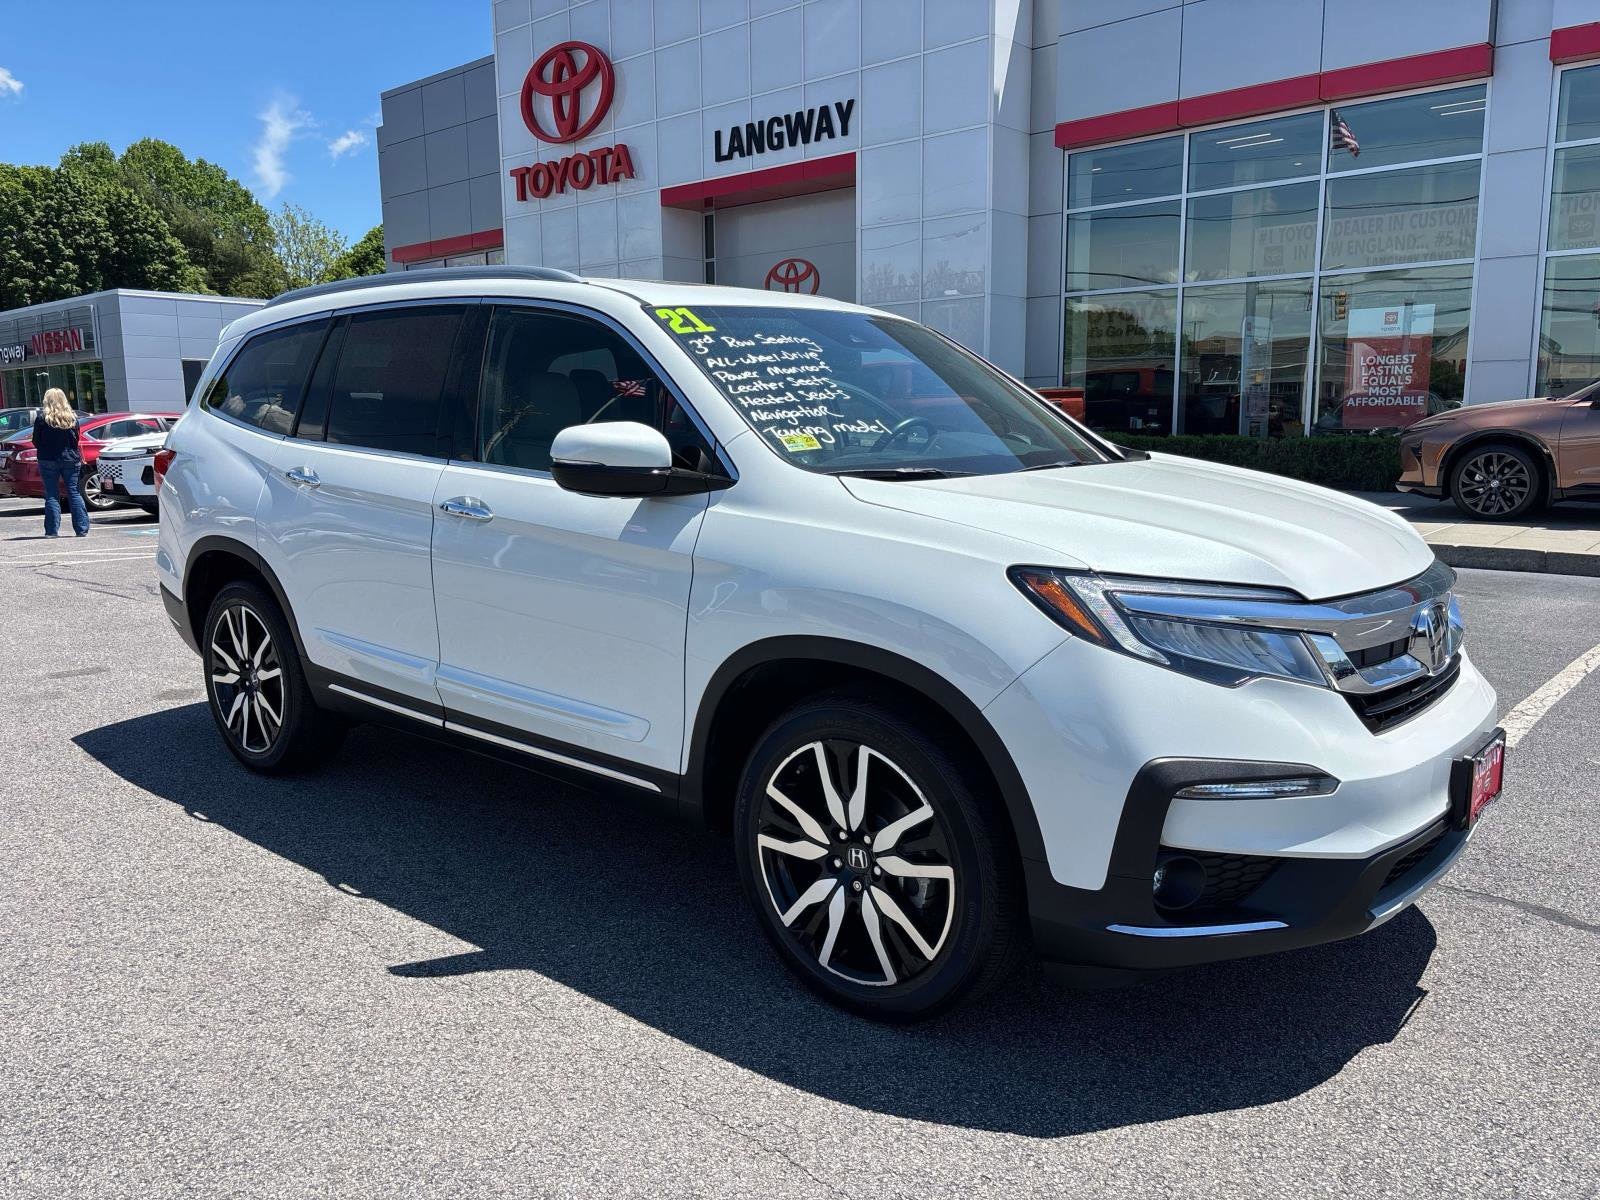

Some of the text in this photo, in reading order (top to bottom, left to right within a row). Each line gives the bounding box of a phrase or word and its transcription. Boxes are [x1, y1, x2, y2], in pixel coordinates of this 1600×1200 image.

[714, 99, 855, 162] LANGWAY
[509, 144, 634, 201] TOYOTA
[1278, 226, 1318, 243] TOYO
[1334, 218, 1384, 237] DEALER
[1388, 215, 1405, 231] IN
[1410, 207, 1478, 229] CUSTOME
[1293, 244, 1308, 260] IN
[655, 307, 716, 335] 21
[32, 328, 85, 355] NISSAN
[689, 334, 823, 354] 3rd Row Seating
[1360, 354, 1417, 366] LONGEST
[712, 371, 759, 382] Power
[1361, 365, 1413, 376] LASTING
[728, 375, 837, 393] Leather Seats
[1361, 375, 1412, 386] EQUALS
[738, 388, 851, 407] Heated Seats
[1368, 386, 1403, 396] MOST
[1347, 396, 1424, 407] AFFORDABLE
[750, 405, 845, 425] Navigation
